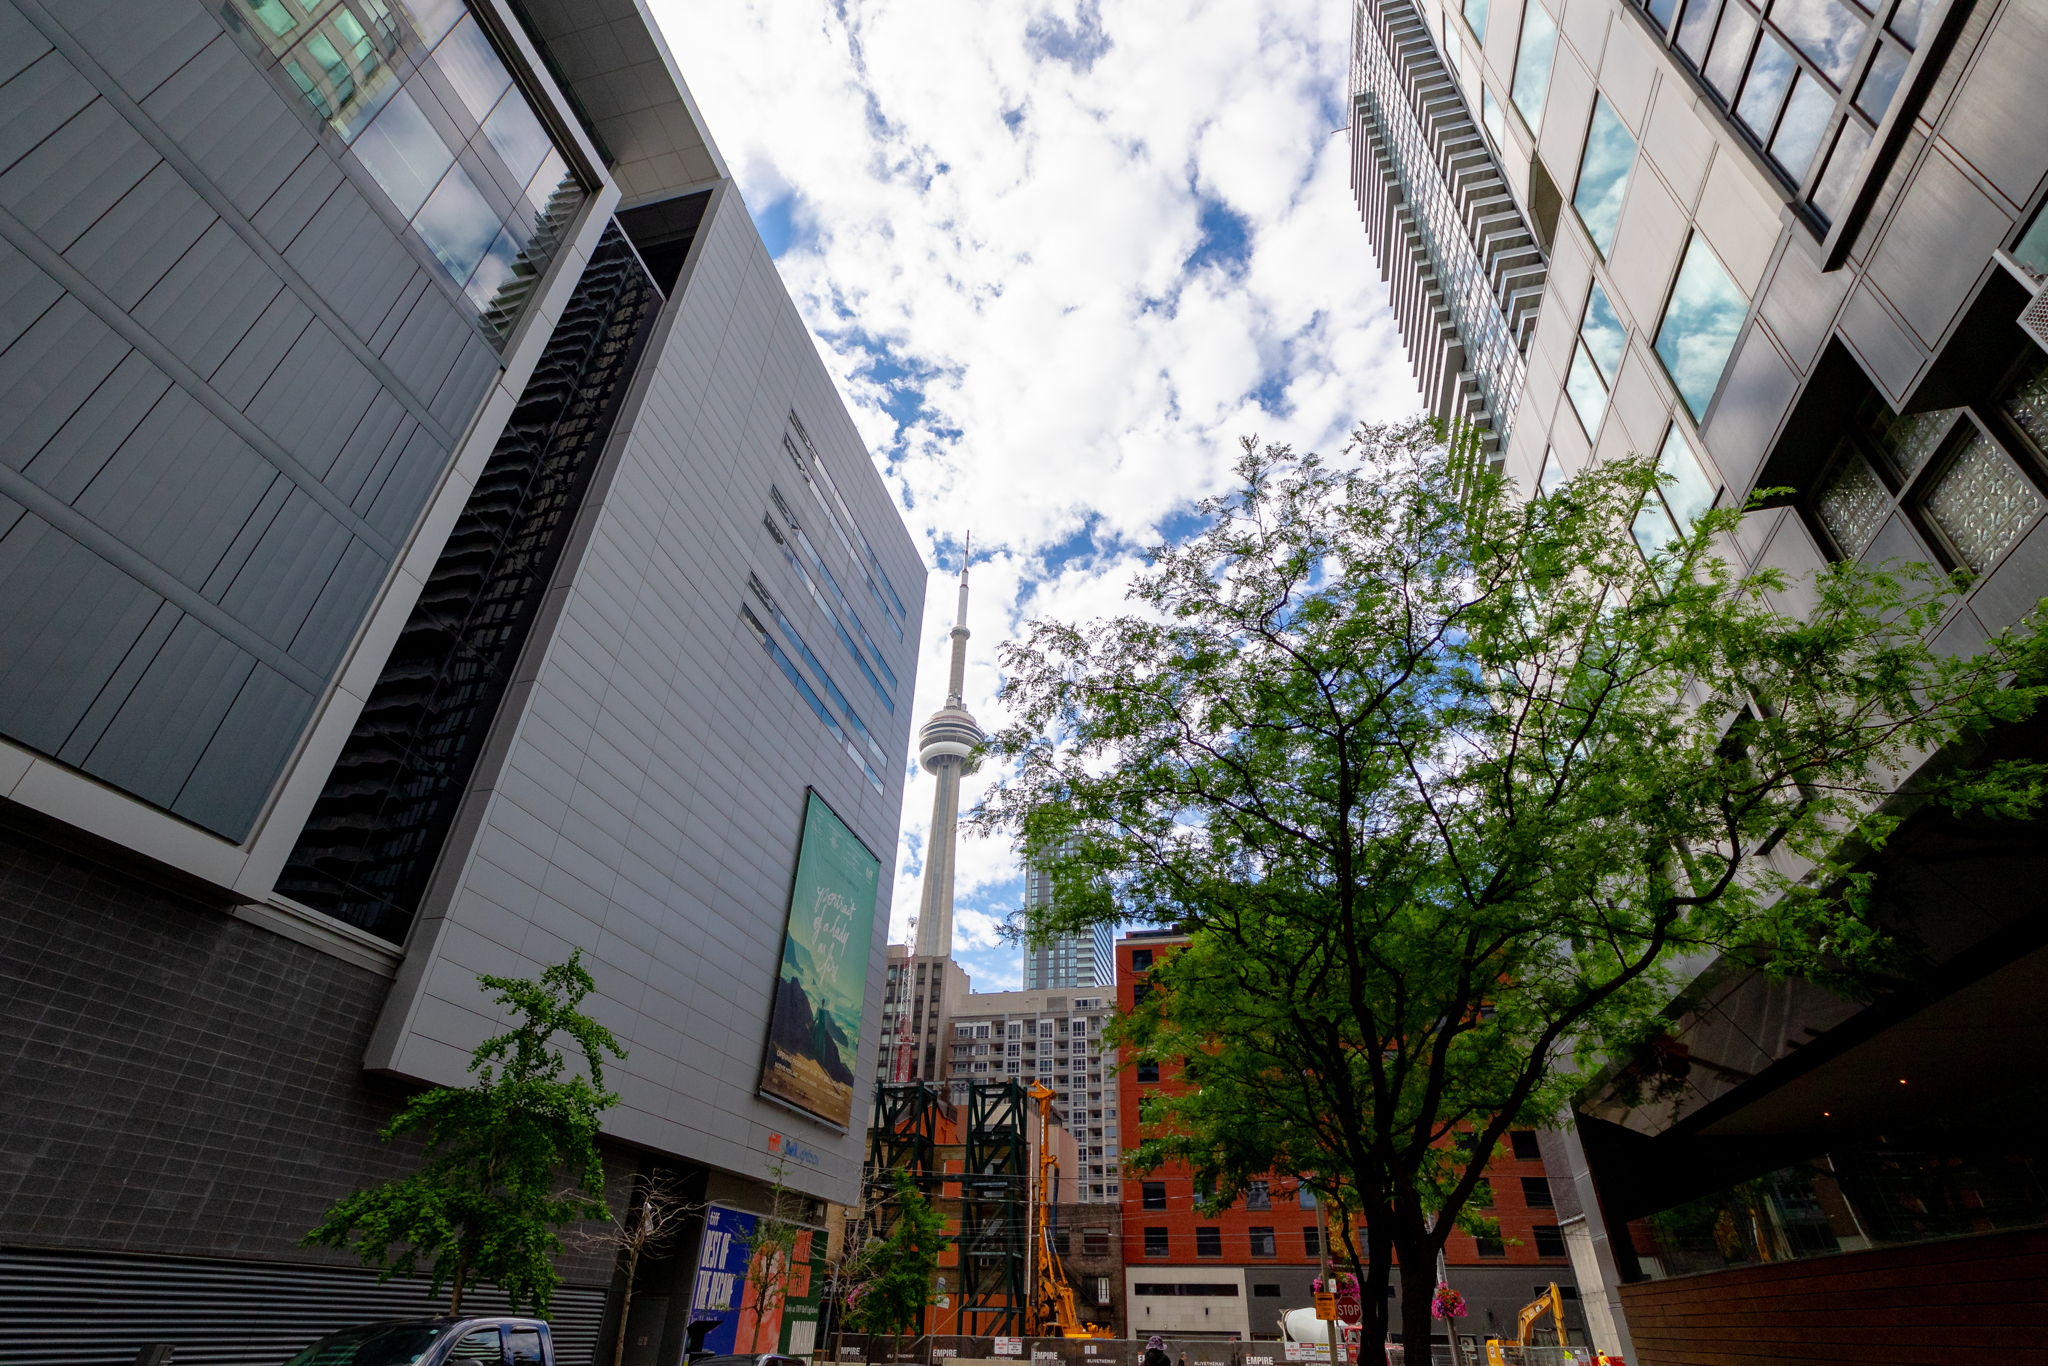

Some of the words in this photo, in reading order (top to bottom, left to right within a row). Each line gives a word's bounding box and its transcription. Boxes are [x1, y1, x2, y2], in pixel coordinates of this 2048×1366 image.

[702, 1230, 723, 1269] BEST
[719, 1233, 732, 1270] OF
[694, 1270, 712, 1310] THE
[1337, 1304, 1360, 1316] STOP
[840, 1346, 861, 1356] MPIRE
[932, 1349, 958, 1358] EMPIRE
[1034, 1351, 1058, 1361] EMPIRE
[1245, 1356, 1274, 1366] EMPIRE
